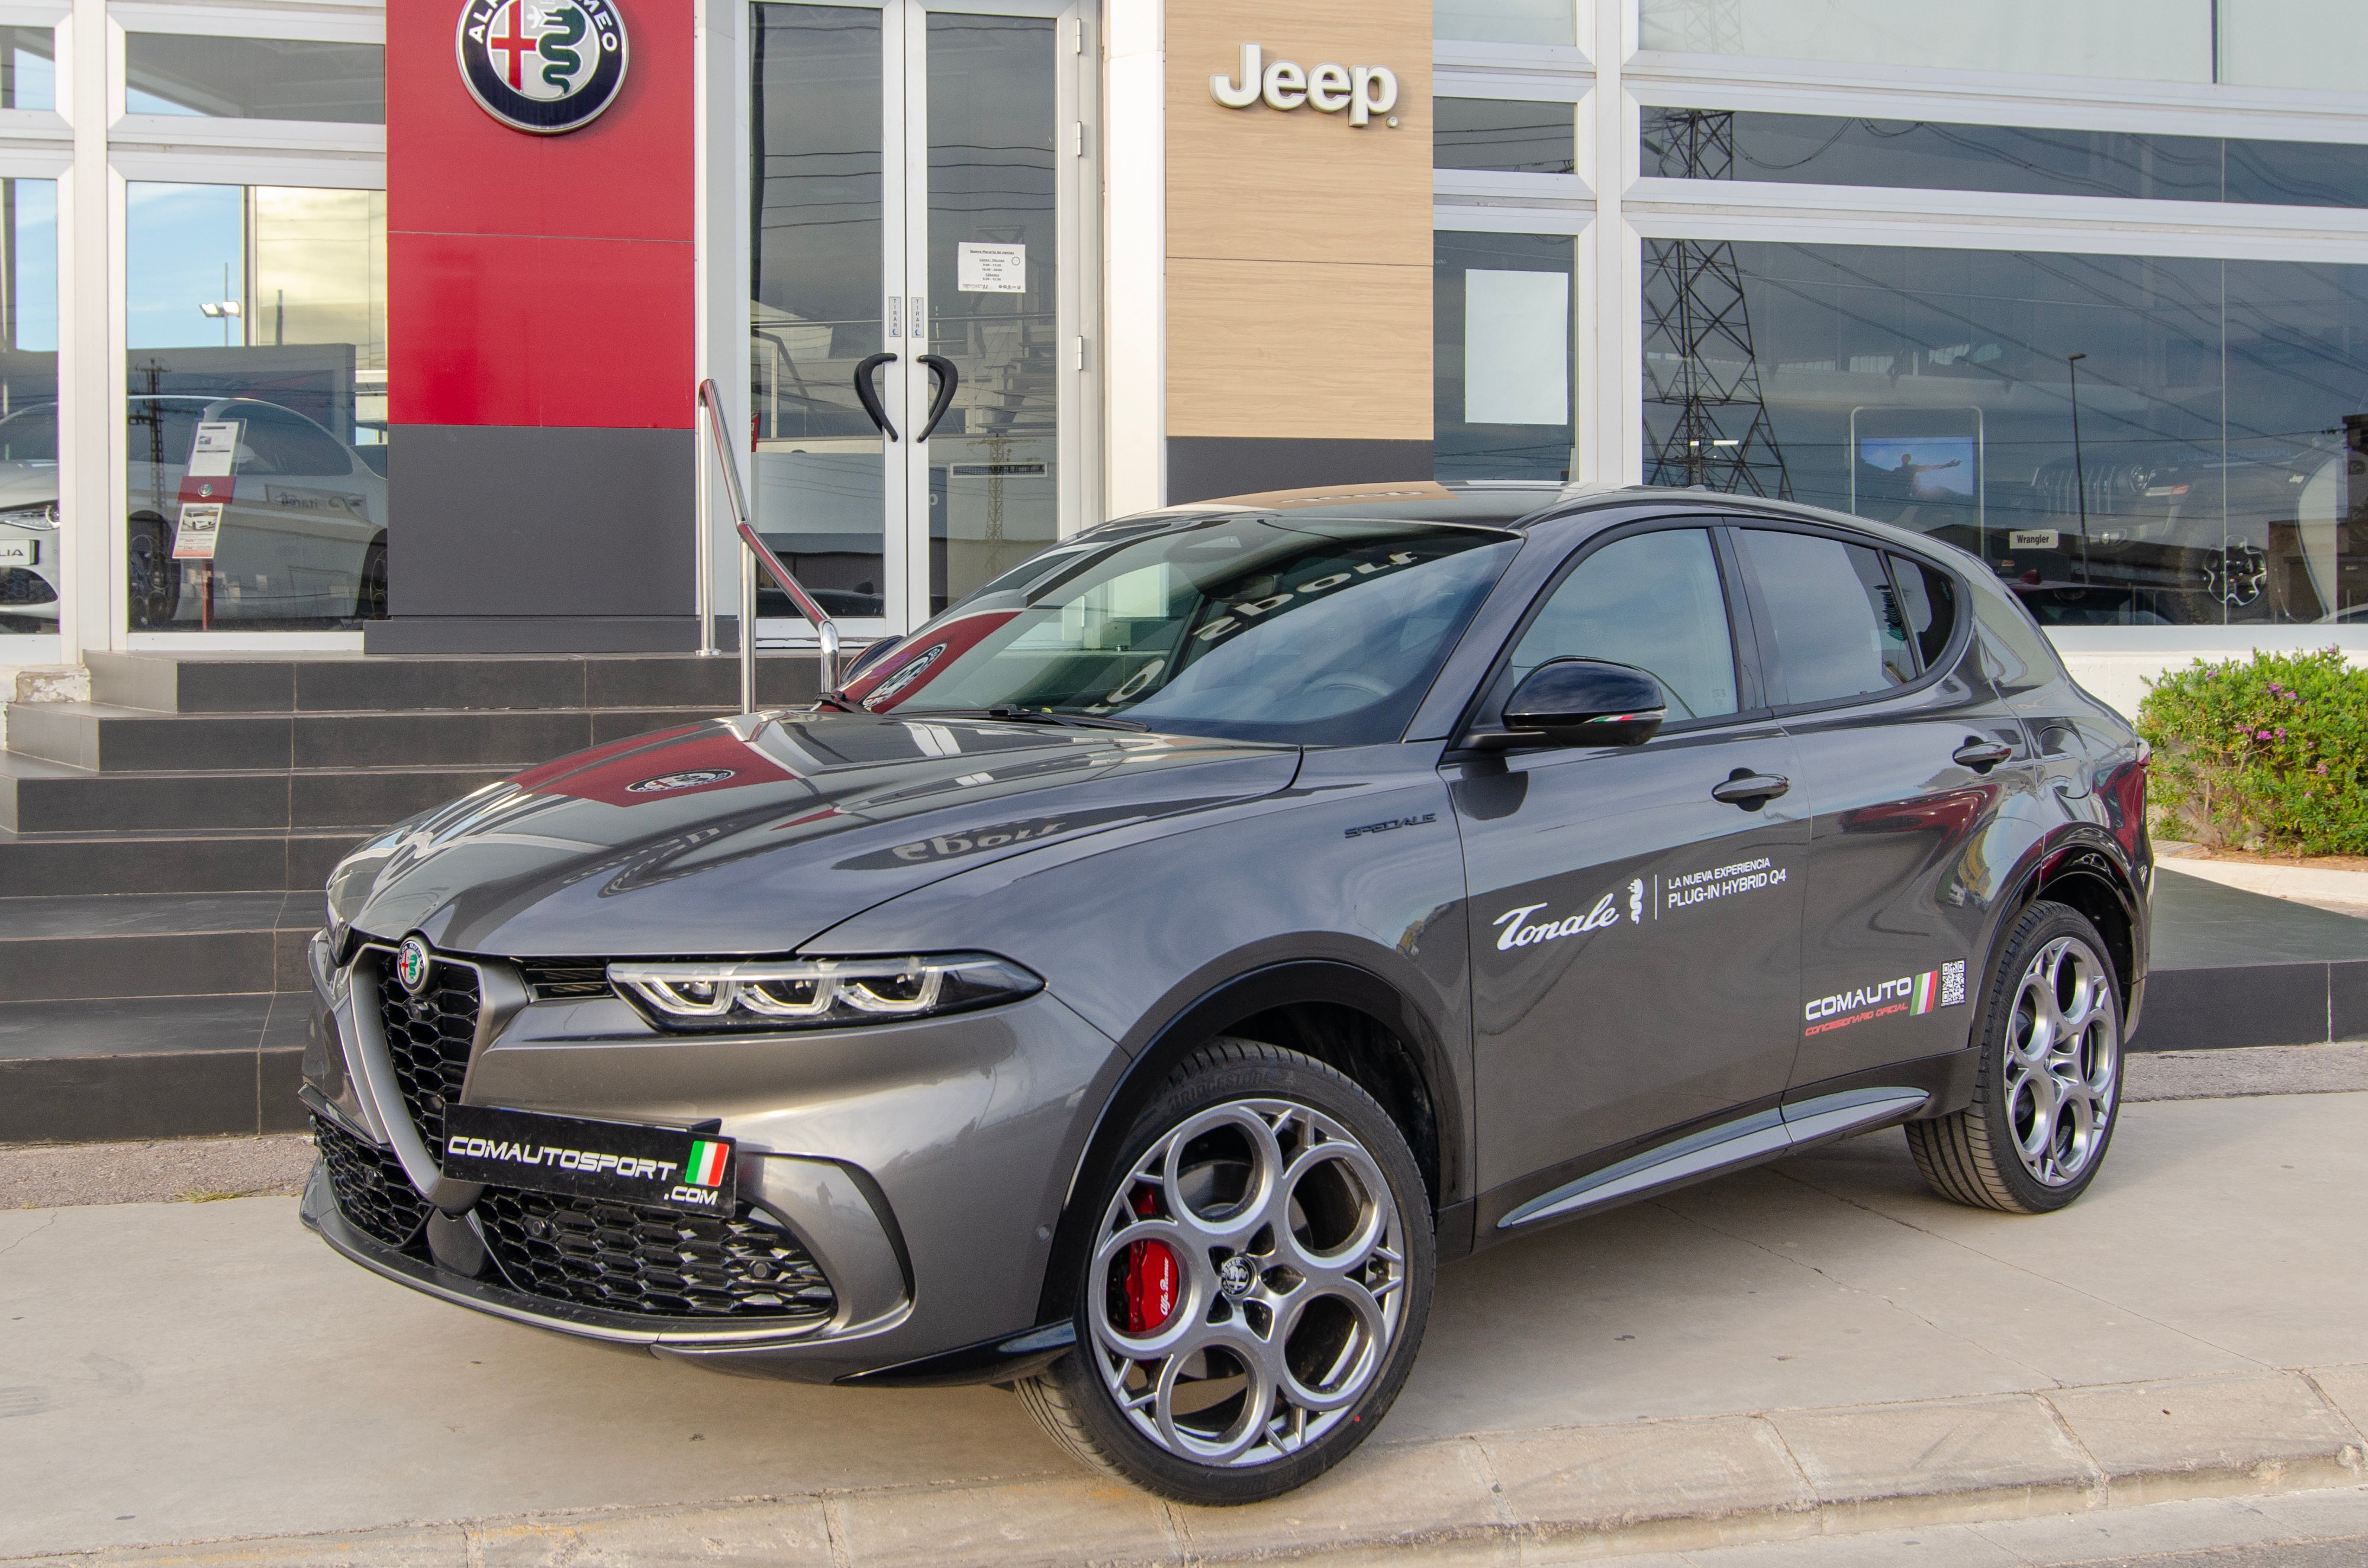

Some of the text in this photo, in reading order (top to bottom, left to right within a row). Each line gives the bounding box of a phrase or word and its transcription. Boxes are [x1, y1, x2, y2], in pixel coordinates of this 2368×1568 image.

[468, 0, 618, 52] ALF MEO
[1209, 42, 1398, 127] Jeep
[2016, 534, 2050, 545] Wrangler
[1344, 812, 1437, 839] SPECIALE
[1668, 857, 1771, 889] LA NUEVA EXPERIENCIA
[1668, 868, 1787, 909] PLUG-IN HYBRID Q4
[1492, 892, 1620, 951] Tonale
[1805, 976, 1912, 1021] COMAUTO
[1876, 1002, 1909, 1017] OFICIAL
[447, 1135, 678, 1182] COMAUTOSPORT
[663, 1185, 719, 1206] .COM
